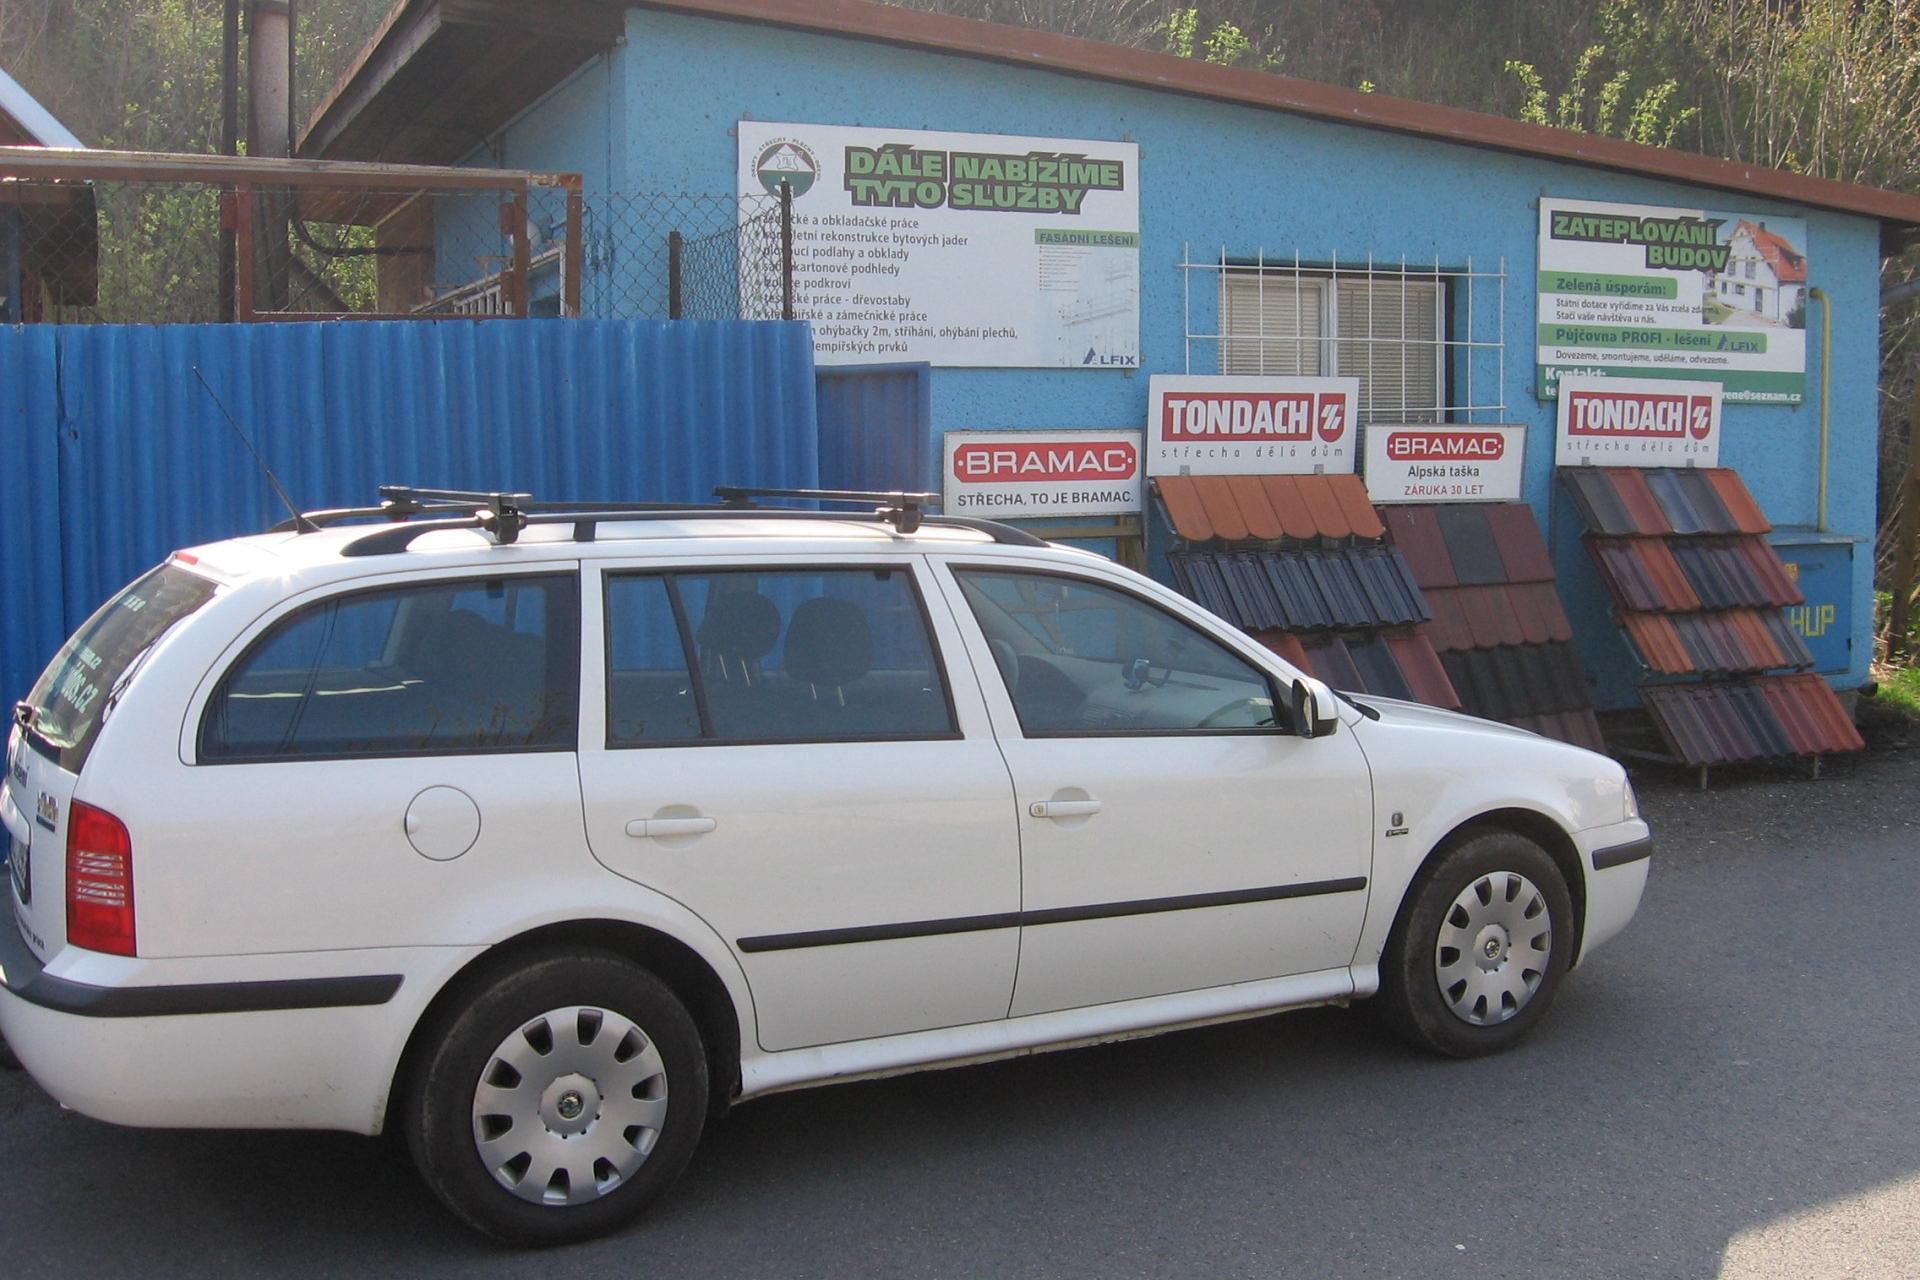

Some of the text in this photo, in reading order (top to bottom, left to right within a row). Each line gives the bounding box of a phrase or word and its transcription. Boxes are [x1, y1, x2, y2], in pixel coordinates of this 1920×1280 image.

[850, 149, 943, 177] DÁLE
[954, 156, 1120, 186] NABÍZÍME
[849, 178, 1082, 210] TYTO SLUŽBY
[812, 216, 819, 225] a
[821, 214, 887, 227] obkladačské
[890, 217, 919, 230] práce
[1554, 215, 1714, 245] ZATEPLOVÁNÍ
[821, 230, 889, 243] rekonstrukce
[892, 233, 939, 247] bytových
[942, 234, 968, 247] jader
[812, 246, 855, 260] podlahy
[857, 249, 864, 258] a
[867, 248, 909, 261] obklady
[1649, 246, 1727, 268] BUDOV
[851, 262, 900, 277] podhledy
[804, 277, 851, 290] podkroví
[1556, 277, 1666, 296] Zelená úsporám:
[812, 294, 842, 306] práce
[852, 294, 910, 307] dřevostaby
[1581, 300, 1607, 309] dotace
[1656, 303, 1669, 312] Vás
[1671, 304, 1690, 312] zcela
[826, 311, 833, 320] a
[836, 310, 896, 321] zámečnické
[899, 311, 927, 323] práce
[1577, 312, 1595, 321] vaše
[1596, 313, 1632, 323] návštěva
[1634, 315, 1640, 323] u
[819, 324, 869, 338] ohýbačky
[872, 325, 891, 337] 2m,
[894, 326, 936, 338] stříhání,
[939, 327, 979, 339] ohýbání
[982, 328, 1018, 340] plechů,
[1556, 328, 1617, 344] Půjčovna
[1621, 331, 1662, 344] PROFI
[812, 340, 908, 354] lempířských prvků
[1556, 350, 1600, 361] Dovezeme,
[1601, 352, 1652, 363] smontujeme,
[1689, 355, 1729, 365] odvezeme.
[1168, 399, 1309, 434] TONDACH
[1573, 398, 1684, 432] TONDACH
[1161, 446, 1240, 459] střecha
[1310, 444, 1343, 457] dům
[1395, 438, 1498, 455] BRAMAC
[1567, 440, 1630, 451] střecha
[1684, 442, 1709, 453] dům
[966, 449, 1126, 475] BRAMAC
[1408, 465, 1480, 479] Alpská taška
[958, 490, 1134, 506] STŘECHA, TO JE BRAMAC.
[1404, 484, 1484, 496] ZÁRUKA 30 LET
[1790, 604, 1835, 637] HUP
